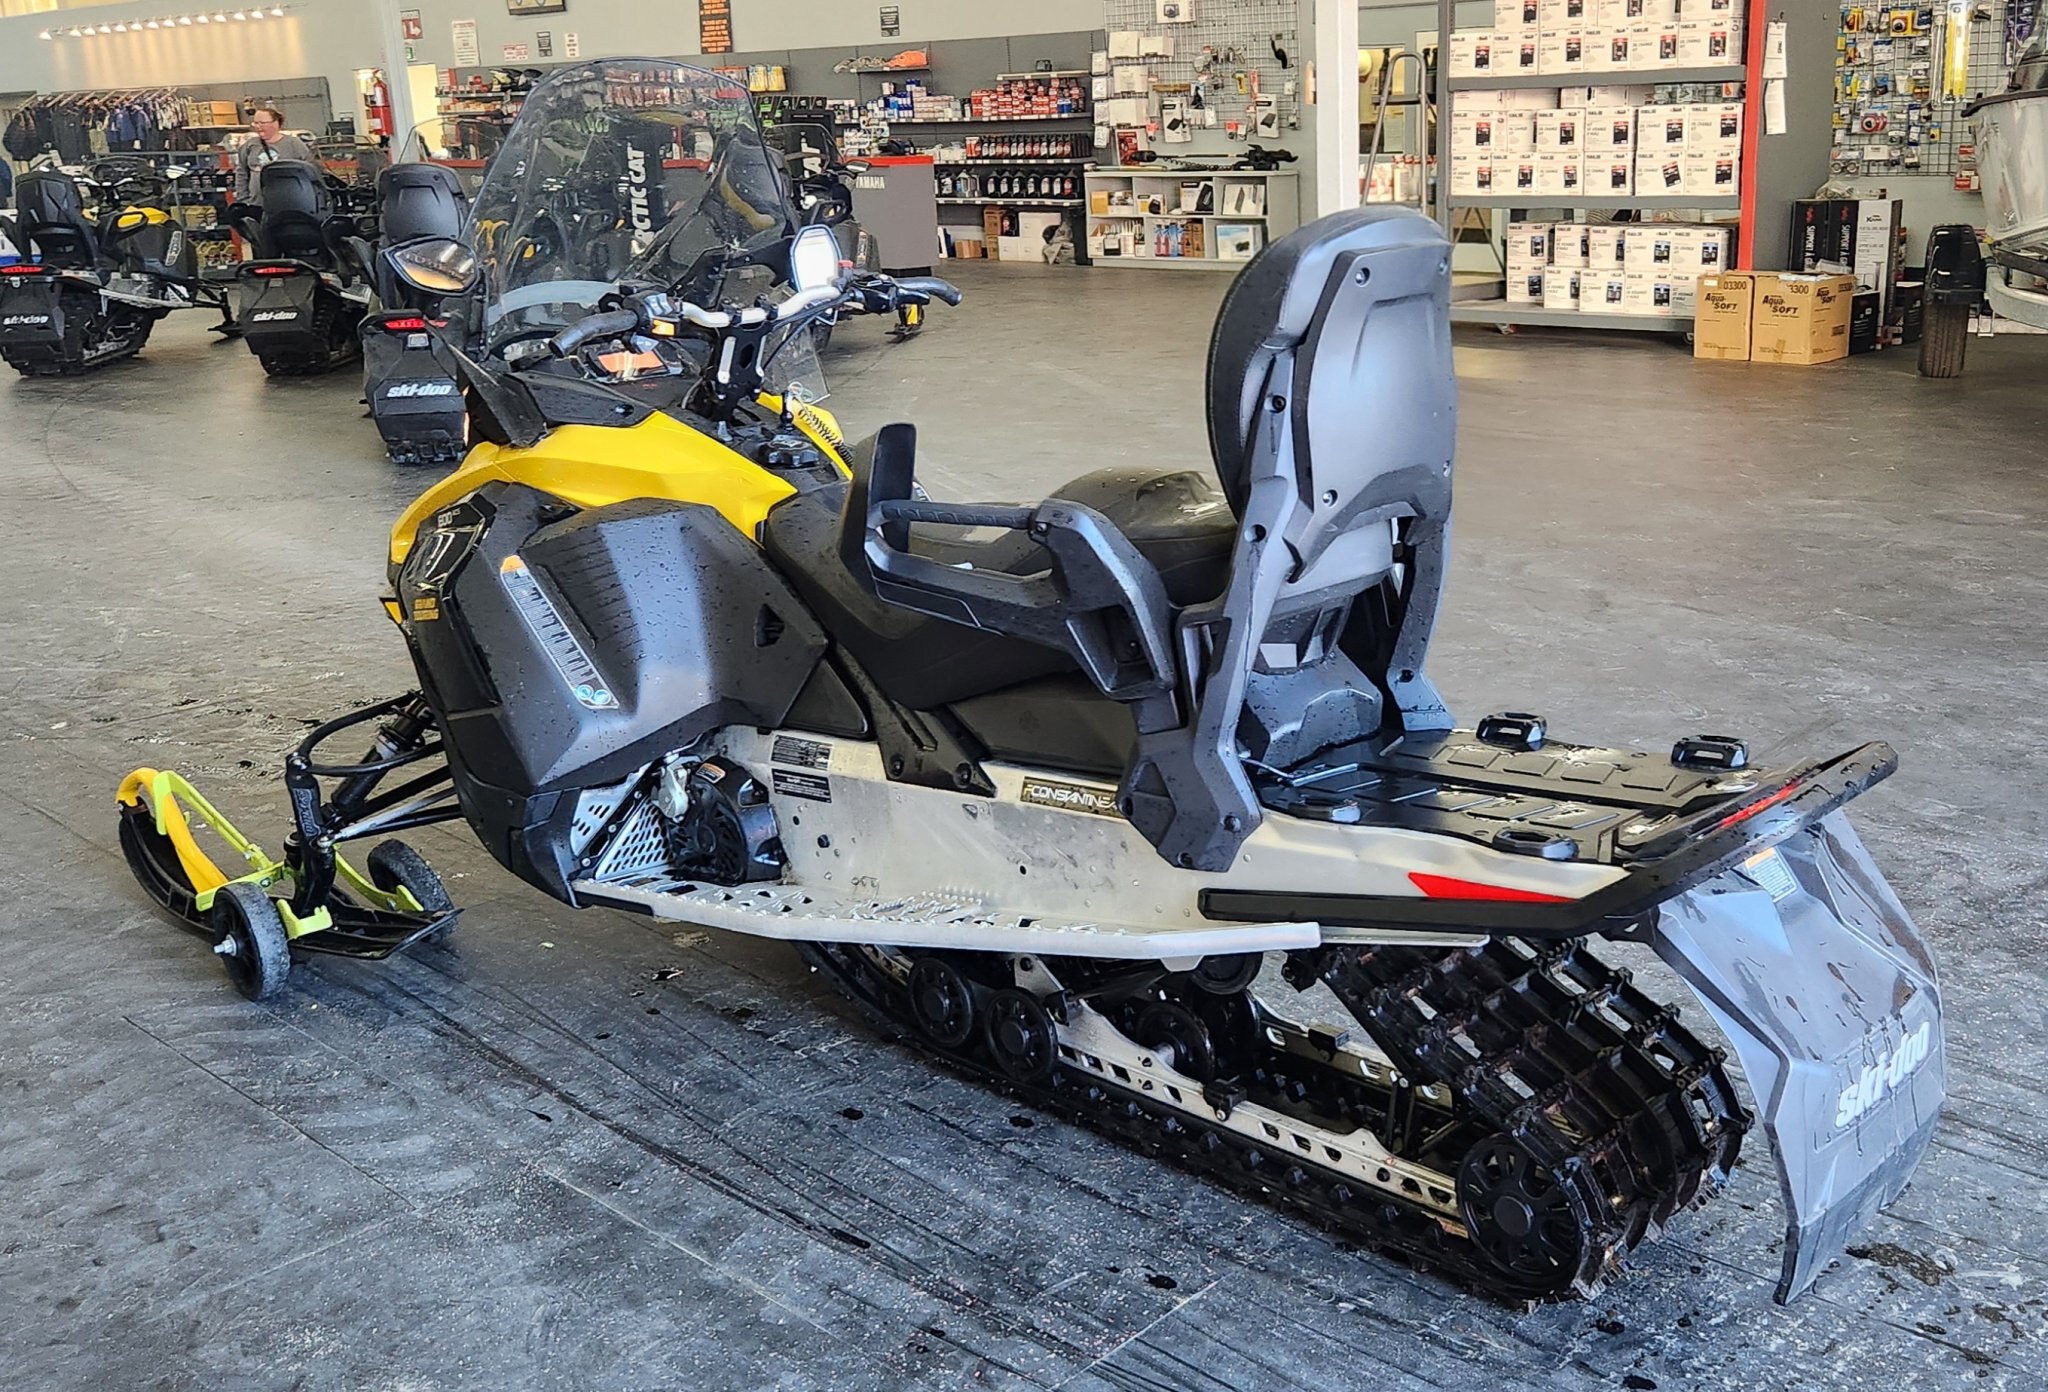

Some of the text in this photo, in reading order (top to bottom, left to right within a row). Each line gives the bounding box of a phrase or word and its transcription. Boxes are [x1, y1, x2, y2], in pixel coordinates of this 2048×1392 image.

[627, 146, 647, 184] CAT
[855, 176, 885, 189] YAMAHA
[1840, 224, 1851, 250] SUPPORT
[1723, 281, 1747, 290] 03300
[1786, 284, 1809, 295] 3300
[1714, 302, 1738, 310] SOFT
[1771, 306, 1799, 314] SOFT
[253, 312, 297, 321] ski-doo
[386, 383, 452, 398] ski-doo
[1834, 1021, 1930, 1128] ski-doo
